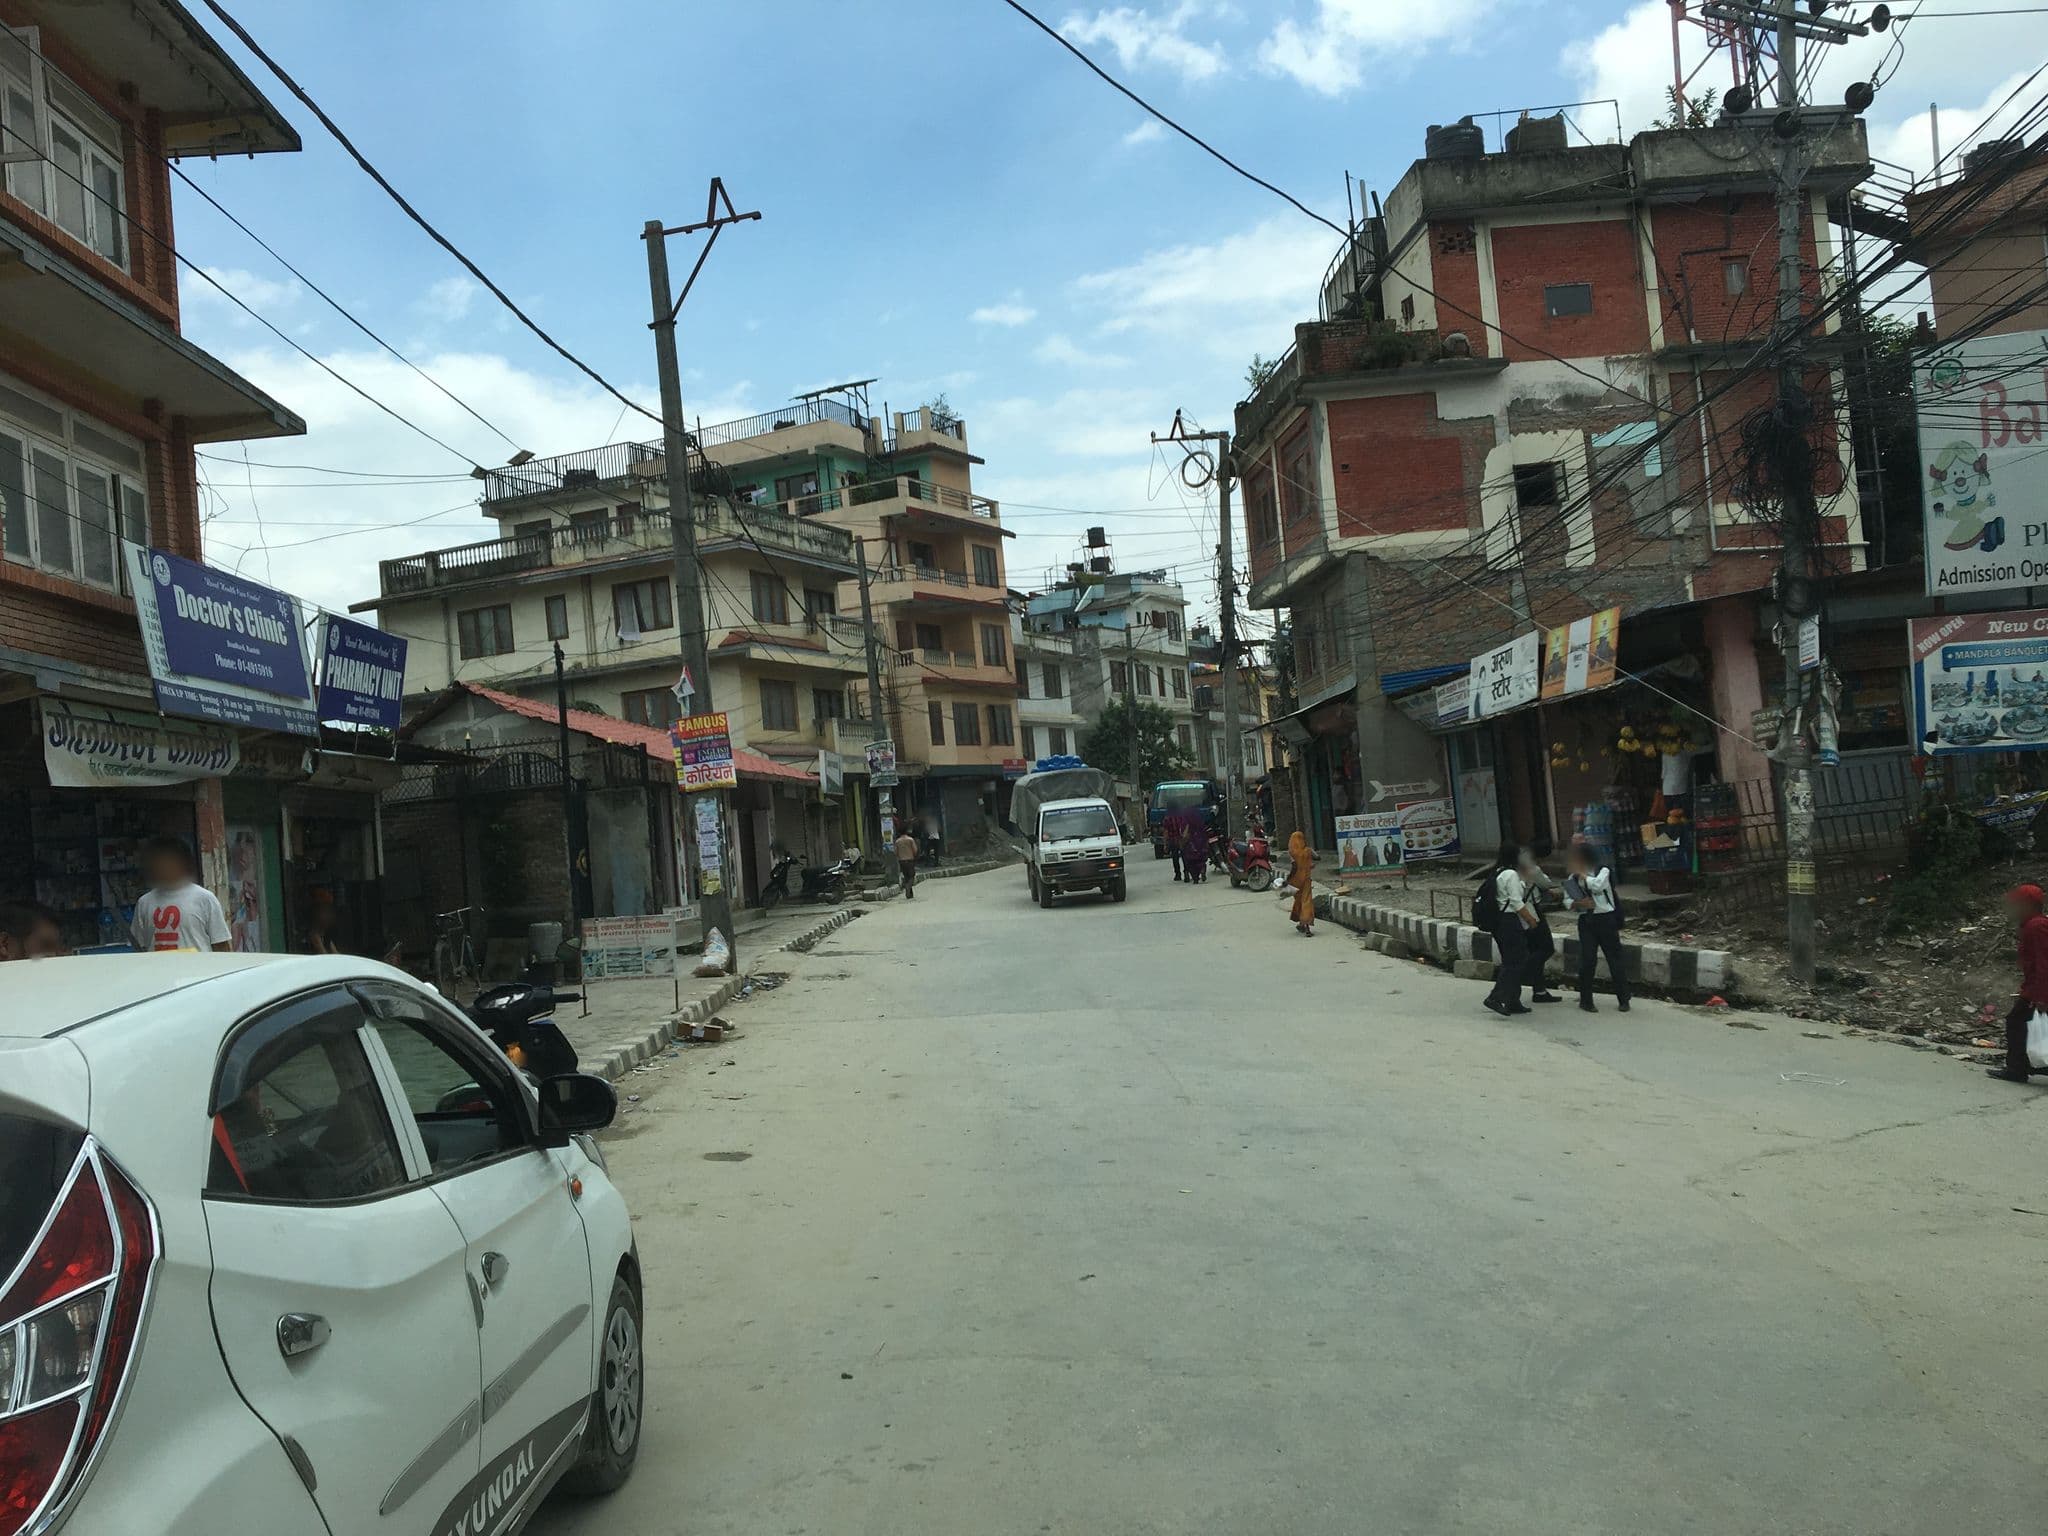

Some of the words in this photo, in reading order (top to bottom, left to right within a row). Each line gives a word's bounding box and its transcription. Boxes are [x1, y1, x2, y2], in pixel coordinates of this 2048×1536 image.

[1938, 563, 2016, 587] Admission
[173, 584, 245, 635] Doctor's
[244, 605, 288, 646] Clinic
[1987, 620, 2029, 634] New
[2033, 617, 2048, 631] C
[1917, 632, 1941, 653] NOW
[1940, 616, 1965, 638] OPEN
[1954, 649, 2001, 660] MANDALA
[326, 653, 382, 697] PHARMACY
[381, 668, 402, 701] UNIT
[1491, 673, 1512, 701] स्टोर
[678, 713, 727, 733] FAMOUS
[698, 746, 730, 756] ENGLISH
[685, 764, 733, 785] कोरियन
[448, 1440, 536, 1536] YUNDAI
